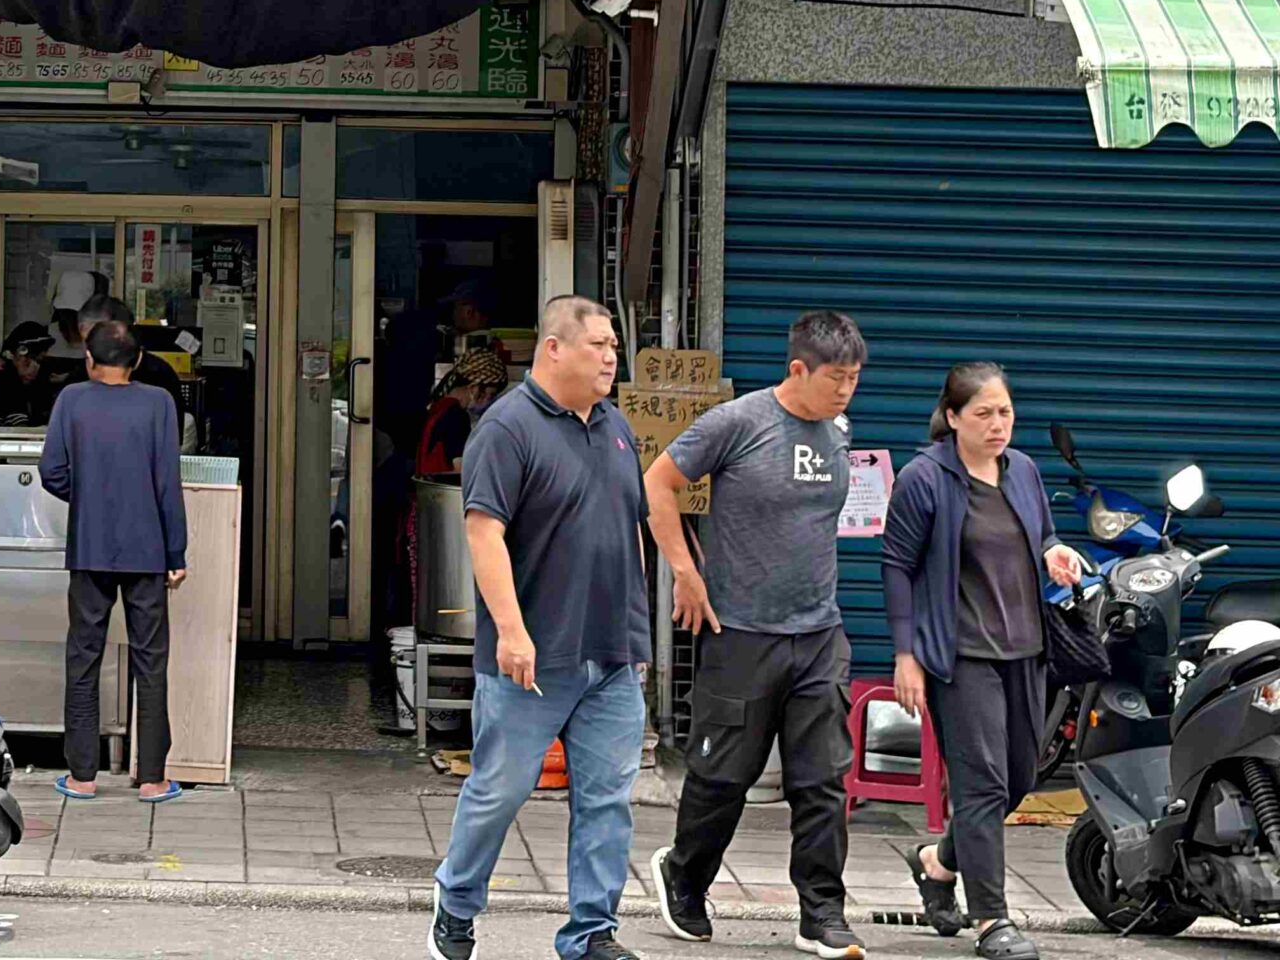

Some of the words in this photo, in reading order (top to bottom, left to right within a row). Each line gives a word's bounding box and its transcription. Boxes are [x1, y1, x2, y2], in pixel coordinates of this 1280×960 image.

[295, 68, 325, 86] 50
[390, 70, 415, 90] 60
[432, 70, 461, 90] 60
[793, 444, 825, 474] R+
